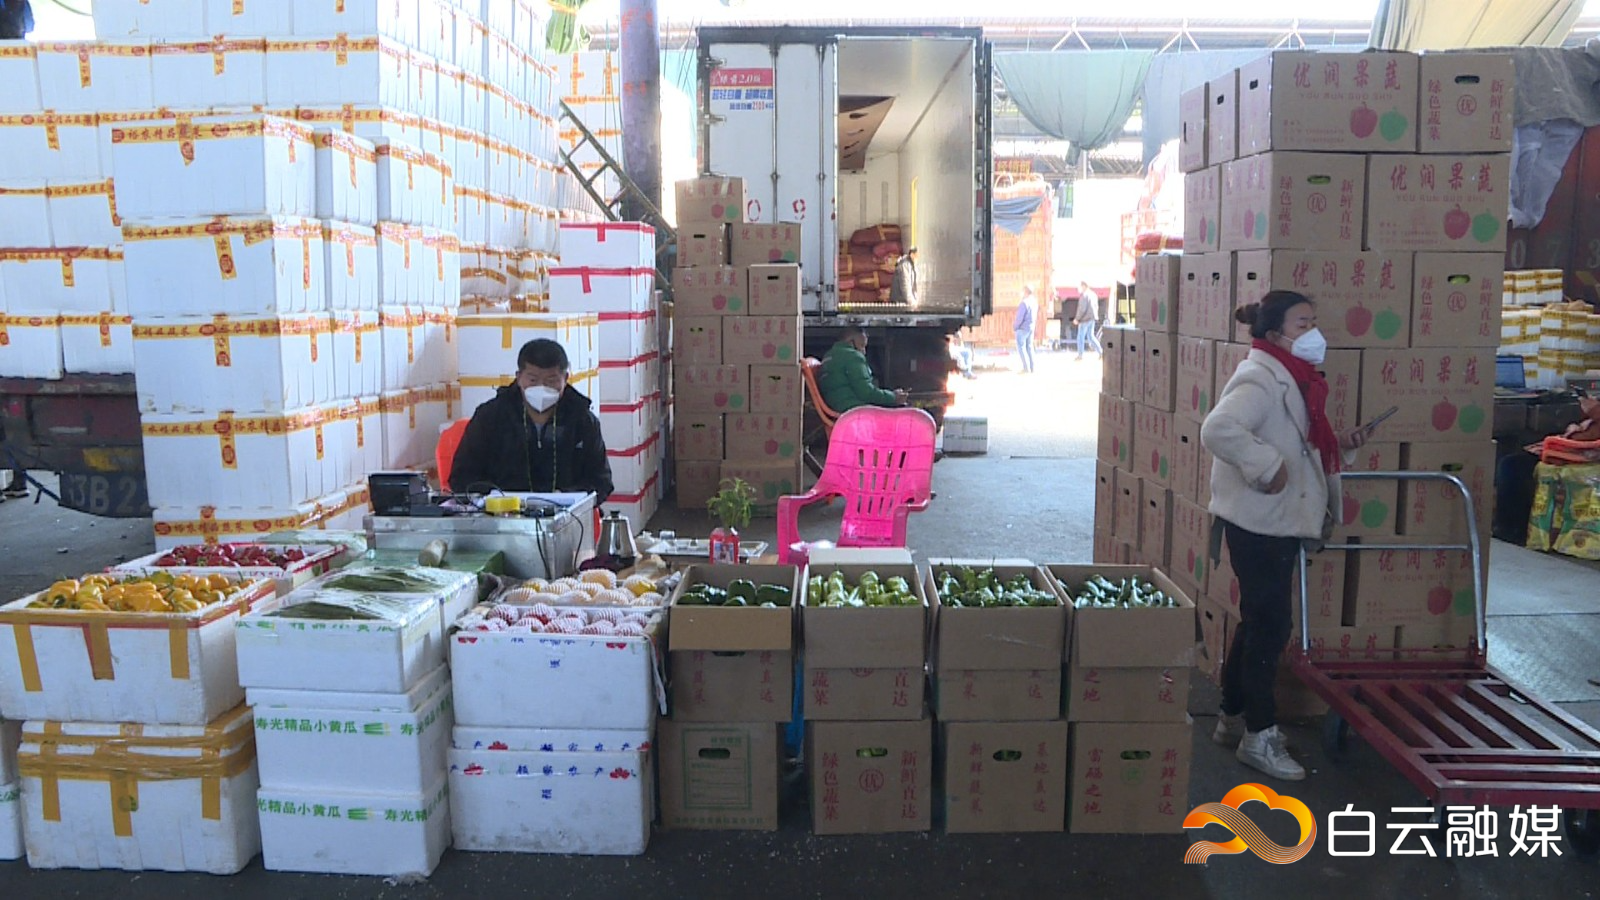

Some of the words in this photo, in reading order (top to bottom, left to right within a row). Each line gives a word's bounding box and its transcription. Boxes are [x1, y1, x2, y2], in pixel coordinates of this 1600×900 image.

[1293, 59, 1401, 90] 优润果蔬
[1427, 80, 1441, 141] 绿色蔬菜
[1489, 79, 1505, 141] 新鲜直达
[1278, 175, 1293, 237] 绿色蔬菜
[1390, 162, 1493, 192] 优润果蔬
[1339, 179, 1355, 240] 新鲜直达
[1292, 259, 1396, 290] 优润果蔬
[1420, 276, 1433, 336] 绿色蔬菜
[1479, 278, 1493, 337] 新鲜直达
[1381, 355, 1480, 385] 优润果蔬
[256, 717, 358, 735] 寿光精品小黄瓜
[257, 799, 341, 818] 光精品小黄瓜
[822, 752, 840, 821] 绿色蔬菜
[900, 750, 918, 820] 新鲜直达
[1158, 747, 1178, 816] 新鲜直达
